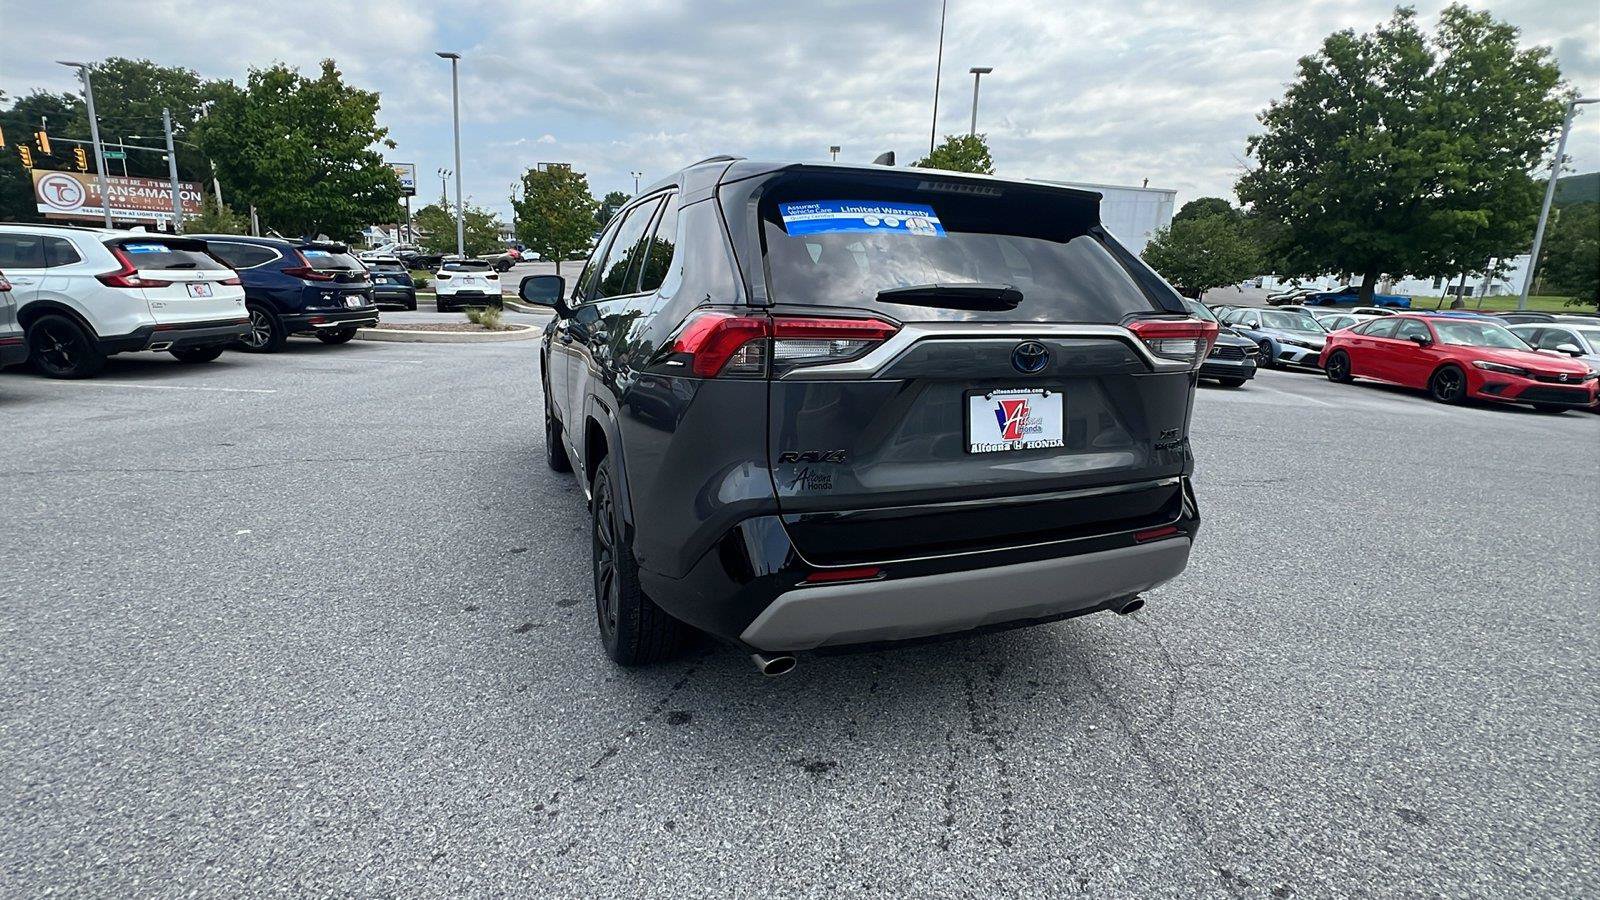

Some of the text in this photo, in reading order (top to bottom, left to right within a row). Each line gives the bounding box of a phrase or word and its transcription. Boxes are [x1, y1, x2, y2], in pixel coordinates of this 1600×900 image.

[87, 183, 201, 201] TANS4MATON
[841, 206, 929, 217] Limited Warranty
[1019, 425, 1042, 434] Honda
[971, 440, 1065, 454] Altoona HONDA
[778, 449, 847, 464] RAV4
[808, 482, 833, 490] Honda
